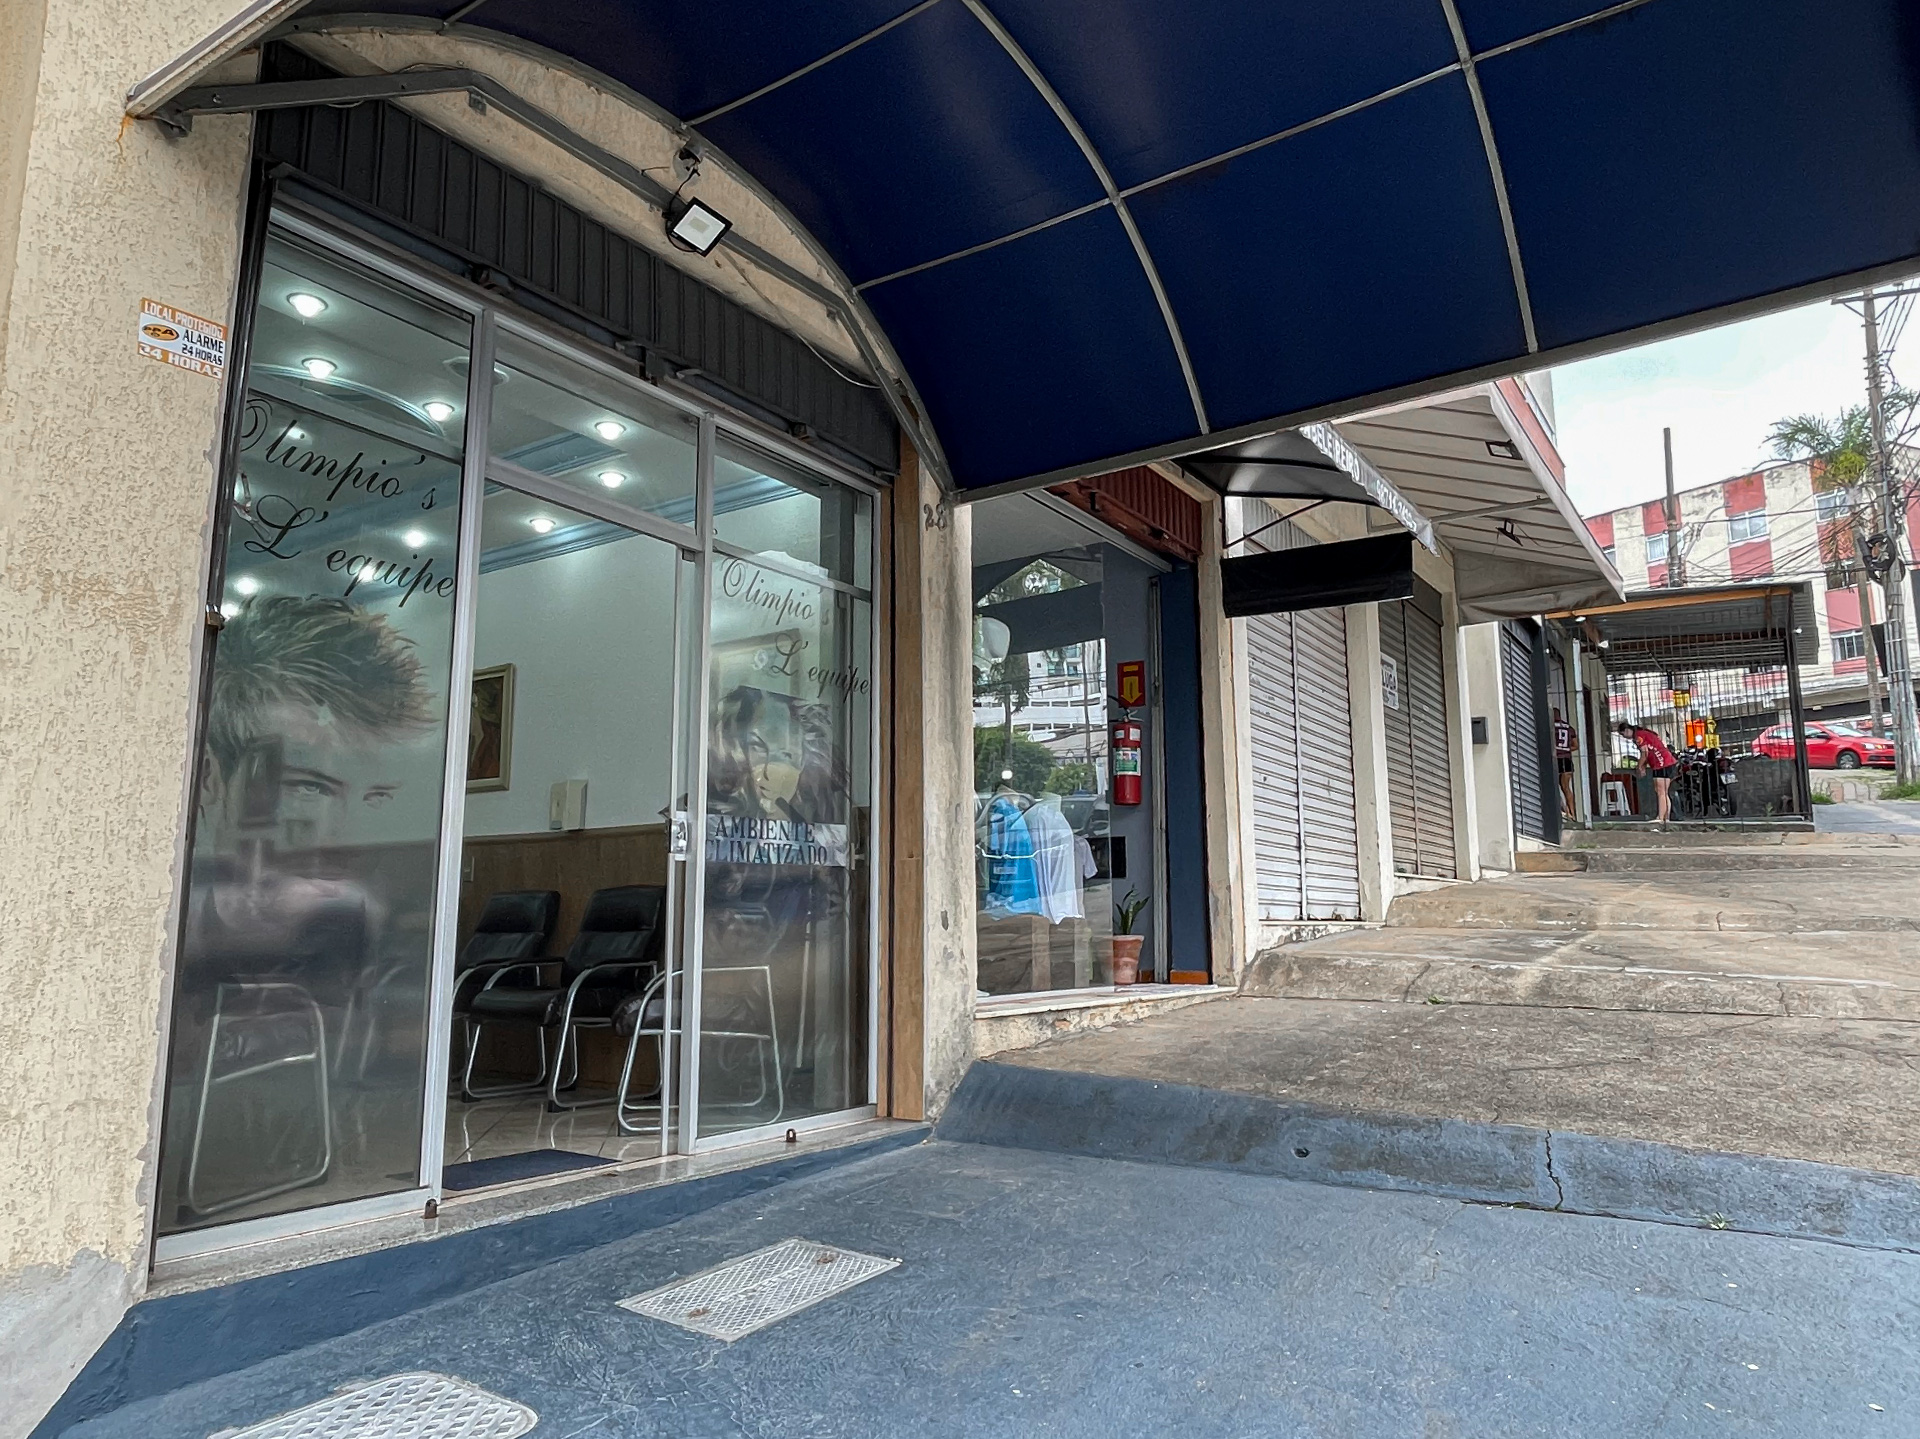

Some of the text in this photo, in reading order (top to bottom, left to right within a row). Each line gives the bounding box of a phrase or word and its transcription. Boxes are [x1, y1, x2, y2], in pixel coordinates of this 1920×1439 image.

[144, 300, 173, 322] LOCAL
[181, 344, 222, 366] 24 HORAS
[183, 329, 224, 354] ALARME
[139, 345, 223, 379] 24 HORAS
[923, 503, 947, 531] 28
[326, 549, 455, 608] equipe
[715, 815, 816, 843] AMBIENTE
